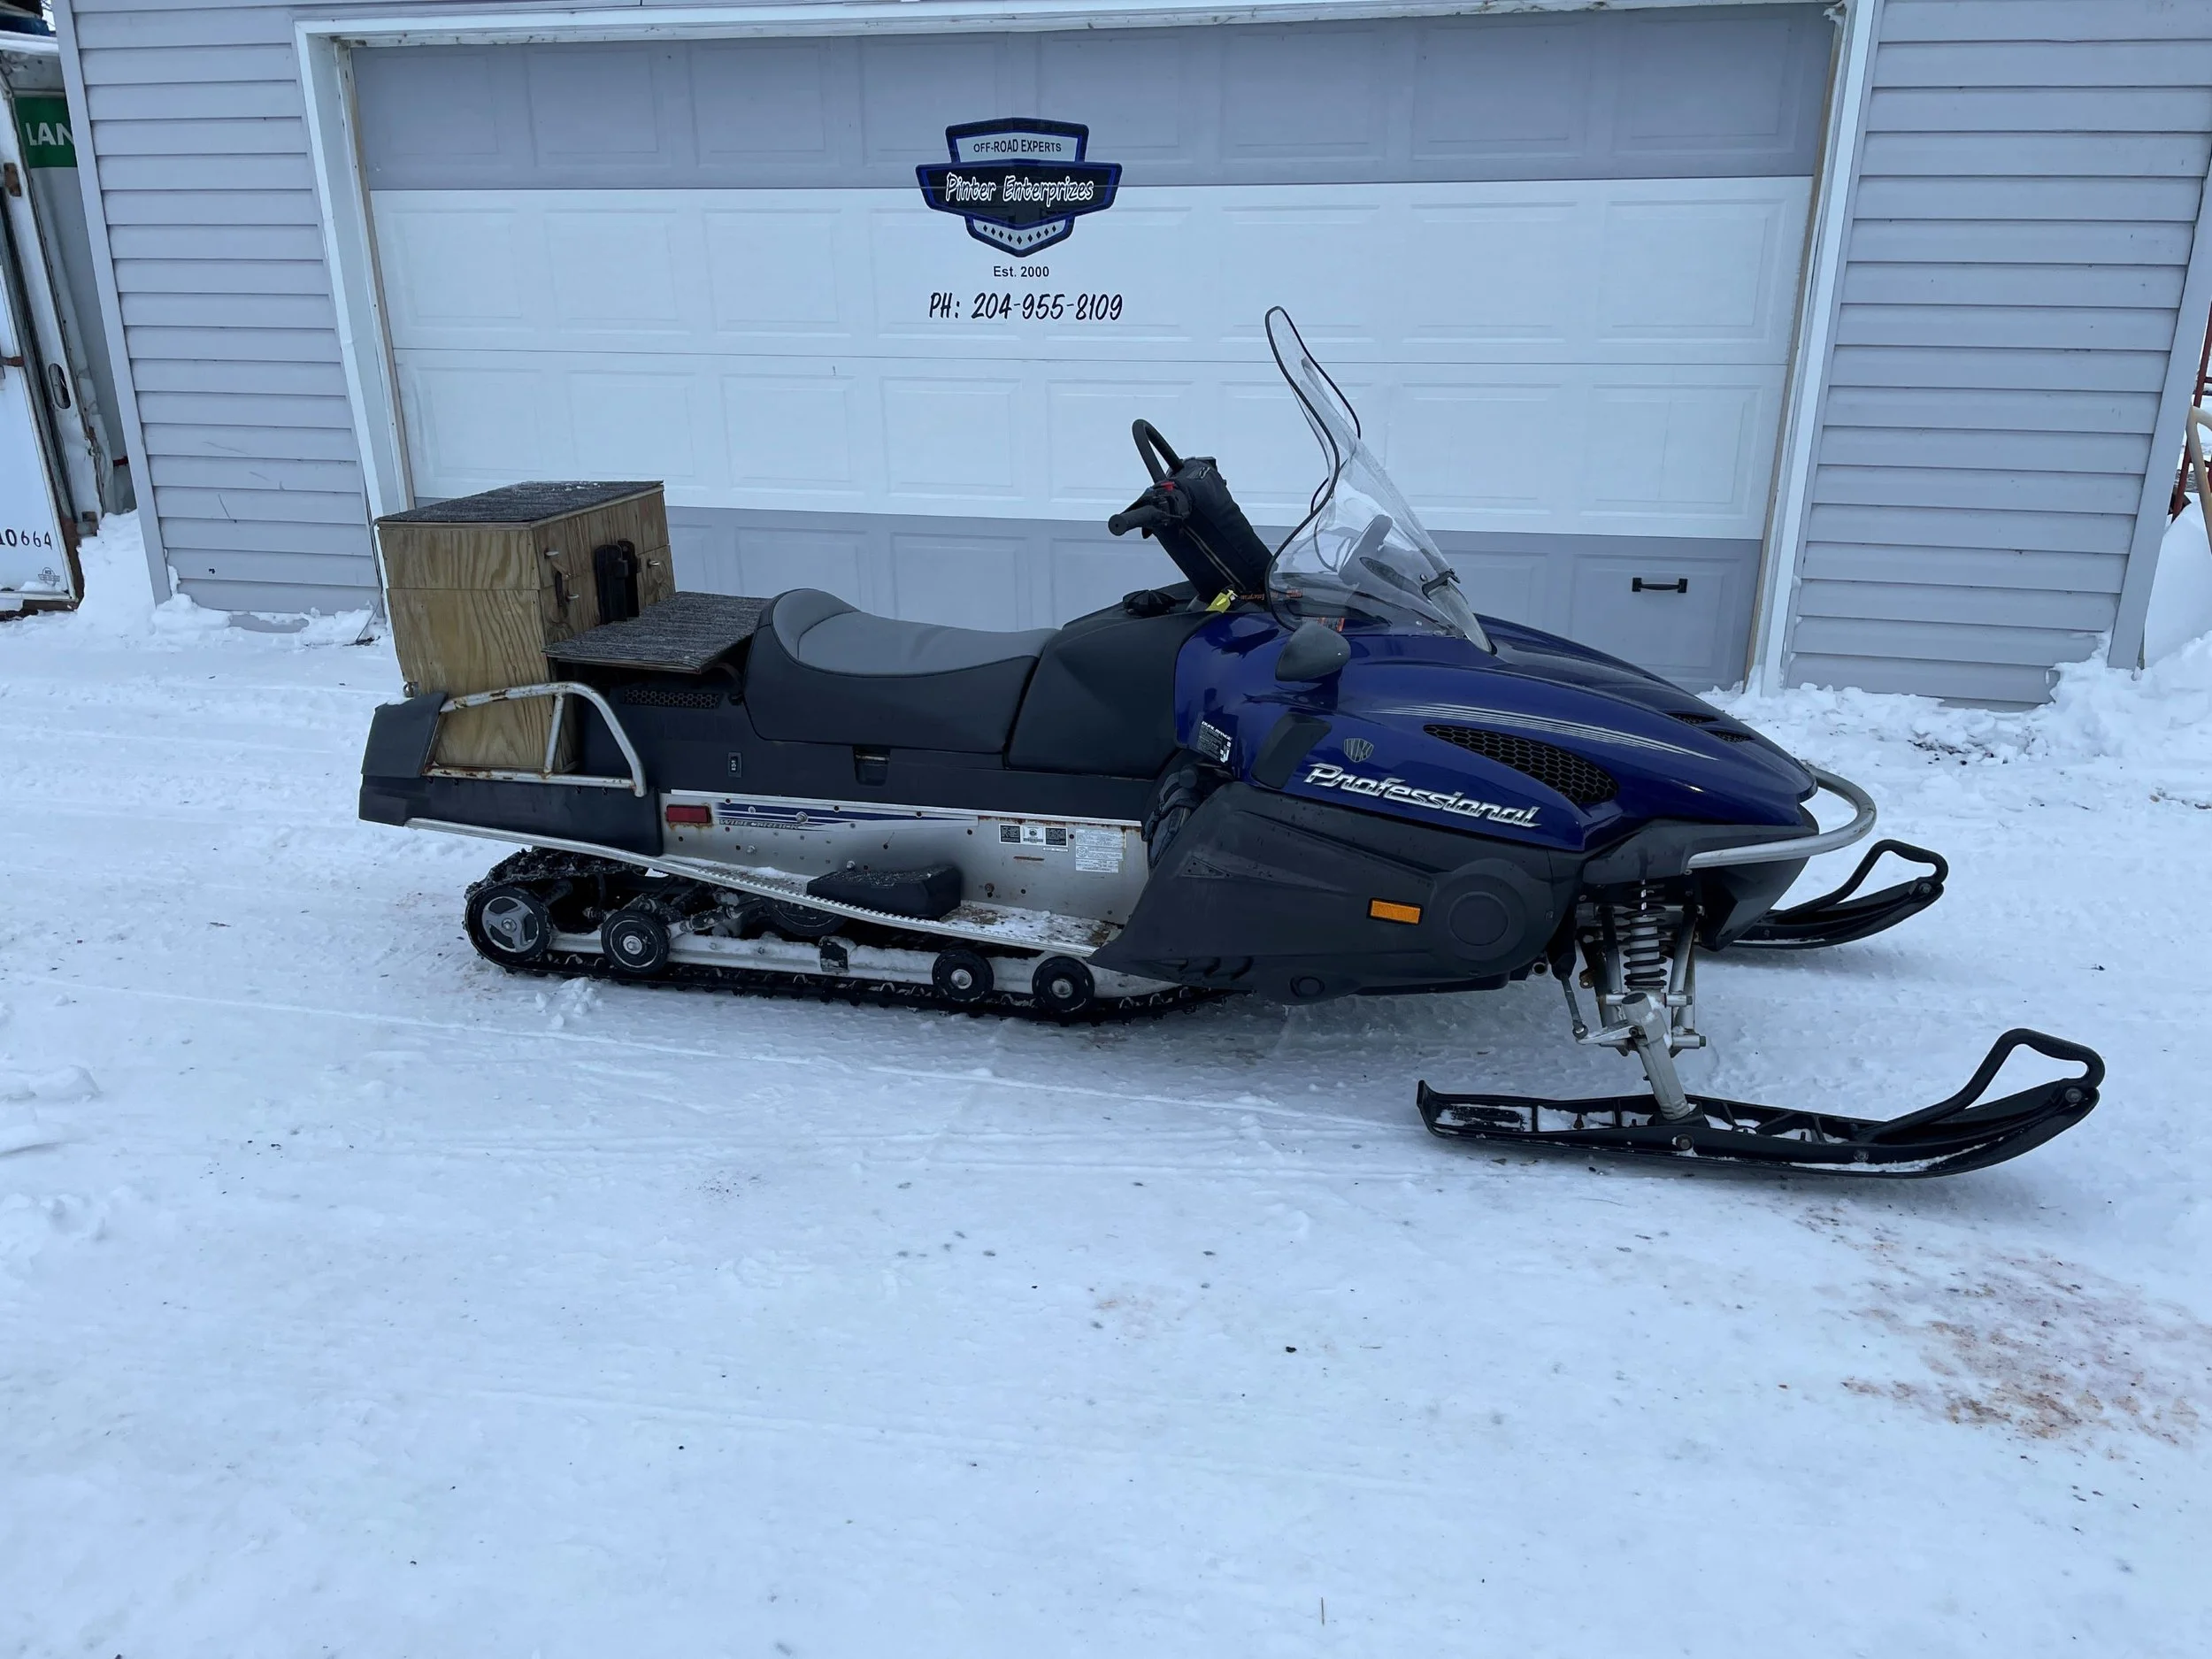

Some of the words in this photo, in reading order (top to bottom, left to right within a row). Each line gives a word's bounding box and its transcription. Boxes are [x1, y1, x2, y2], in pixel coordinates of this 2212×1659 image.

[973, 139, 1018, 152] OFF-ROAD
[1021, 140, 1062, 153] EXPERTS
[945, 172, 996, 202] Pinter
[1002, 174, 1094, 207] Enterprizes
[994, 266, 1017, 277] Est.
[1020, 266, 1049, 277] 2000
[929, 292, 960, 319] PH:
[971, 292, 1123, 321] 204-955-8109
[1303, 763, 1542, 828] Professional
